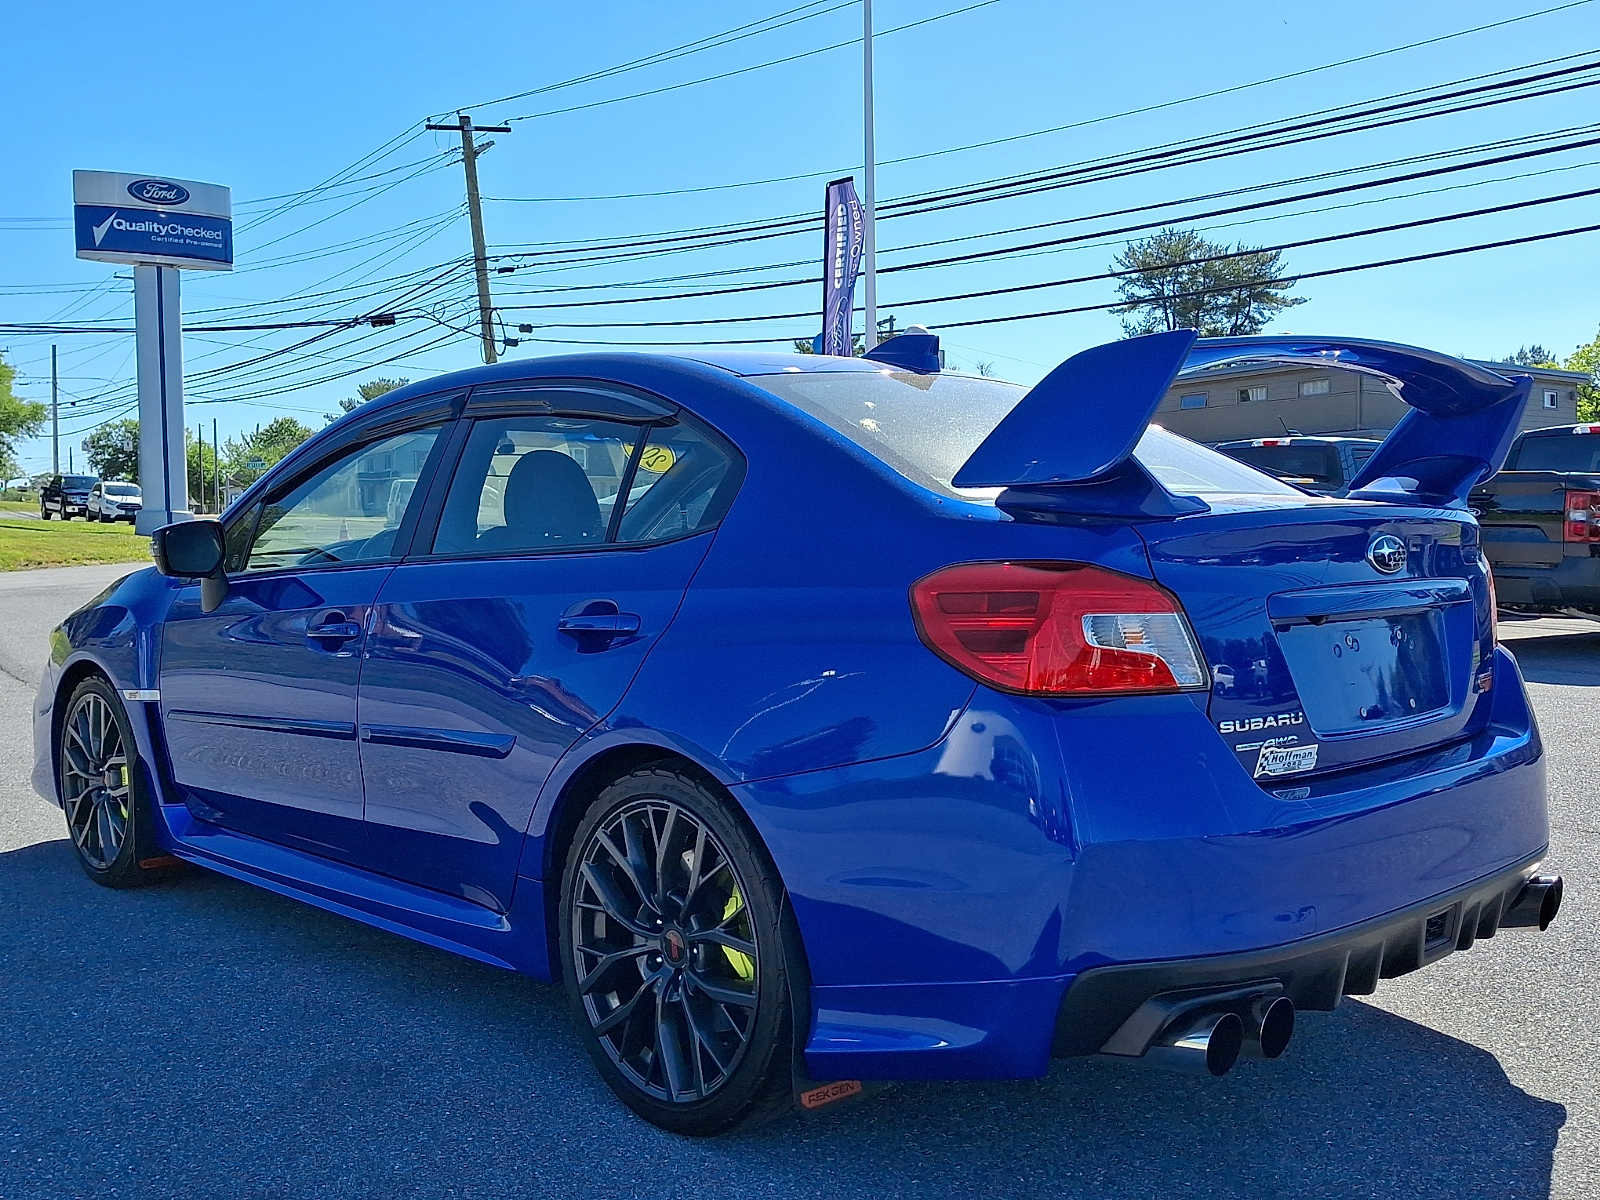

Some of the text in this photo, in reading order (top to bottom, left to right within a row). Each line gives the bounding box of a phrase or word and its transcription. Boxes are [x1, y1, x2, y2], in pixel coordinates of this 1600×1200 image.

[143, 182, 177, 200] Ford
[113, 218, 222, 240] QualityChecked
[151, 235, 184, 244] Certified
[834, 203, 848, 288] CERTIFIED
[1220, 712, 1303, 733] SUBARU
[1271, 751, 1313, 763] Hoffman
